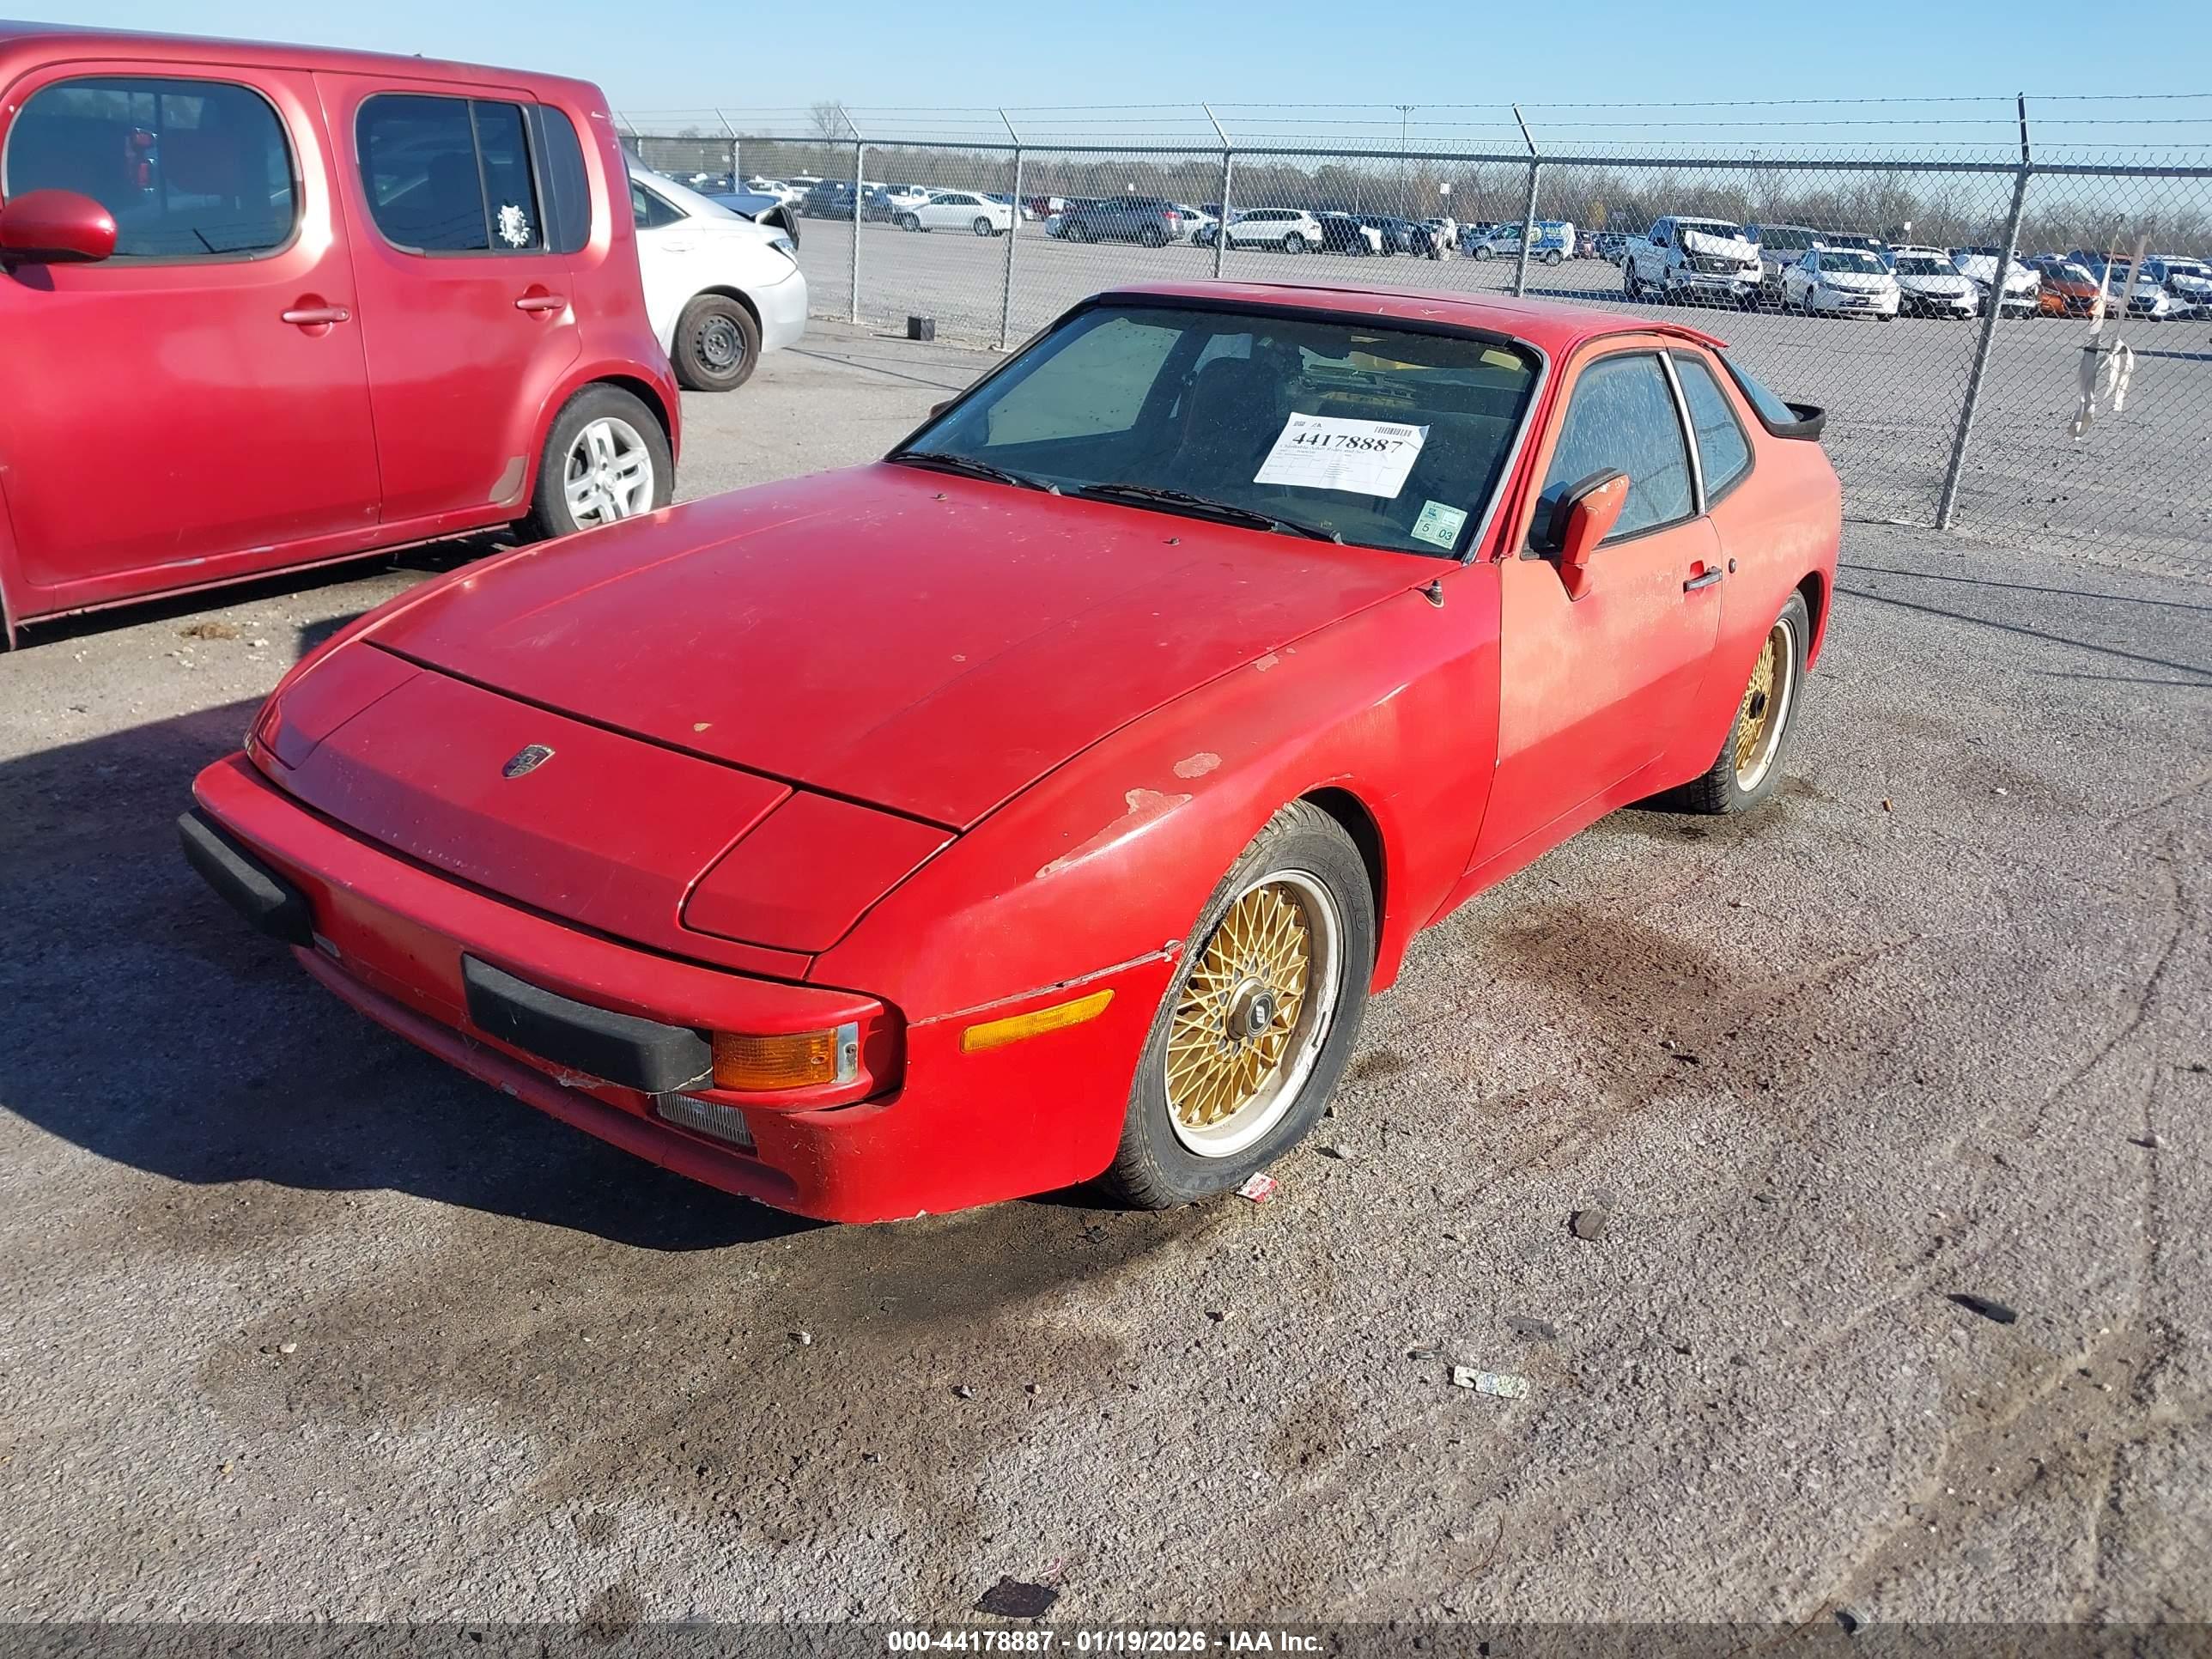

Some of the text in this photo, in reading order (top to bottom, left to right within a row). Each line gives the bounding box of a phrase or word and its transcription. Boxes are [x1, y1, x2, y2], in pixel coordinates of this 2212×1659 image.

[1292, 432, 1403, 453] 44178887
[1422, 523, 1431, 532] 5
[1438, 529, 1453, 540] 03
